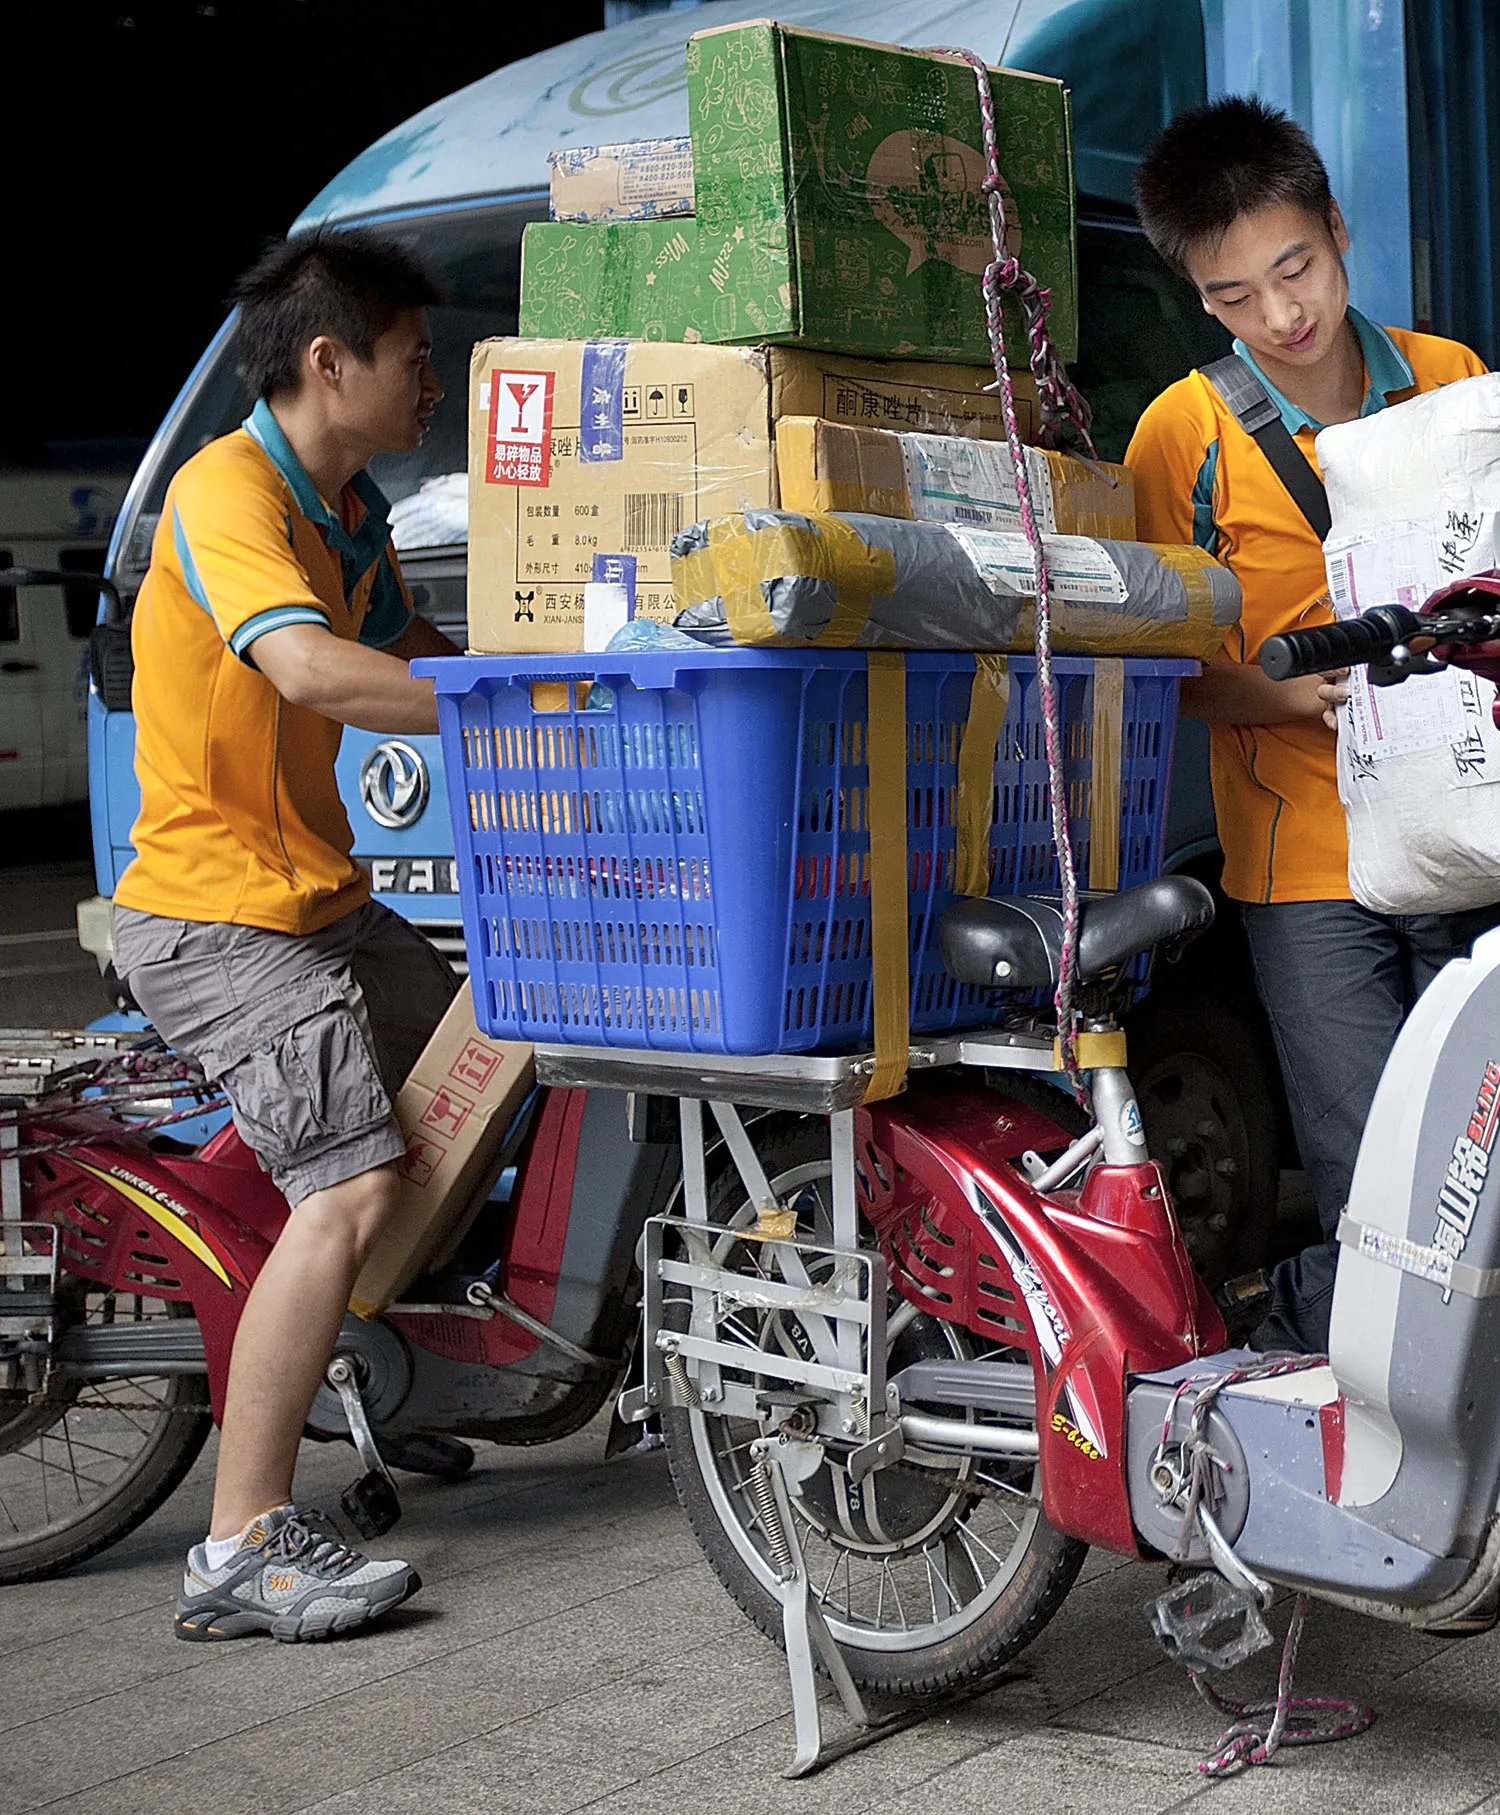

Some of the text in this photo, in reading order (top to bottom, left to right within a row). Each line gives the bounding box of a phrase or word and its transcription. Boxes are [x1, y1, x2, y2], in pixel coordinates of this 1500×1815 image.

[836, 386, 922, 425] 酮康唑片
[494, 444, 543, 464] 易碎物品
[493, 461, 542, 482] 小心轻放
[526, 505, 560, 519] 包装数量
[574, 534, 598, 548] 8.0kg
[525, 562, 560, 575] 外形尺寸
[544, 615, 585, 625] XIAN-JANS
[109, 1165, 159, 1195] LINKEN
